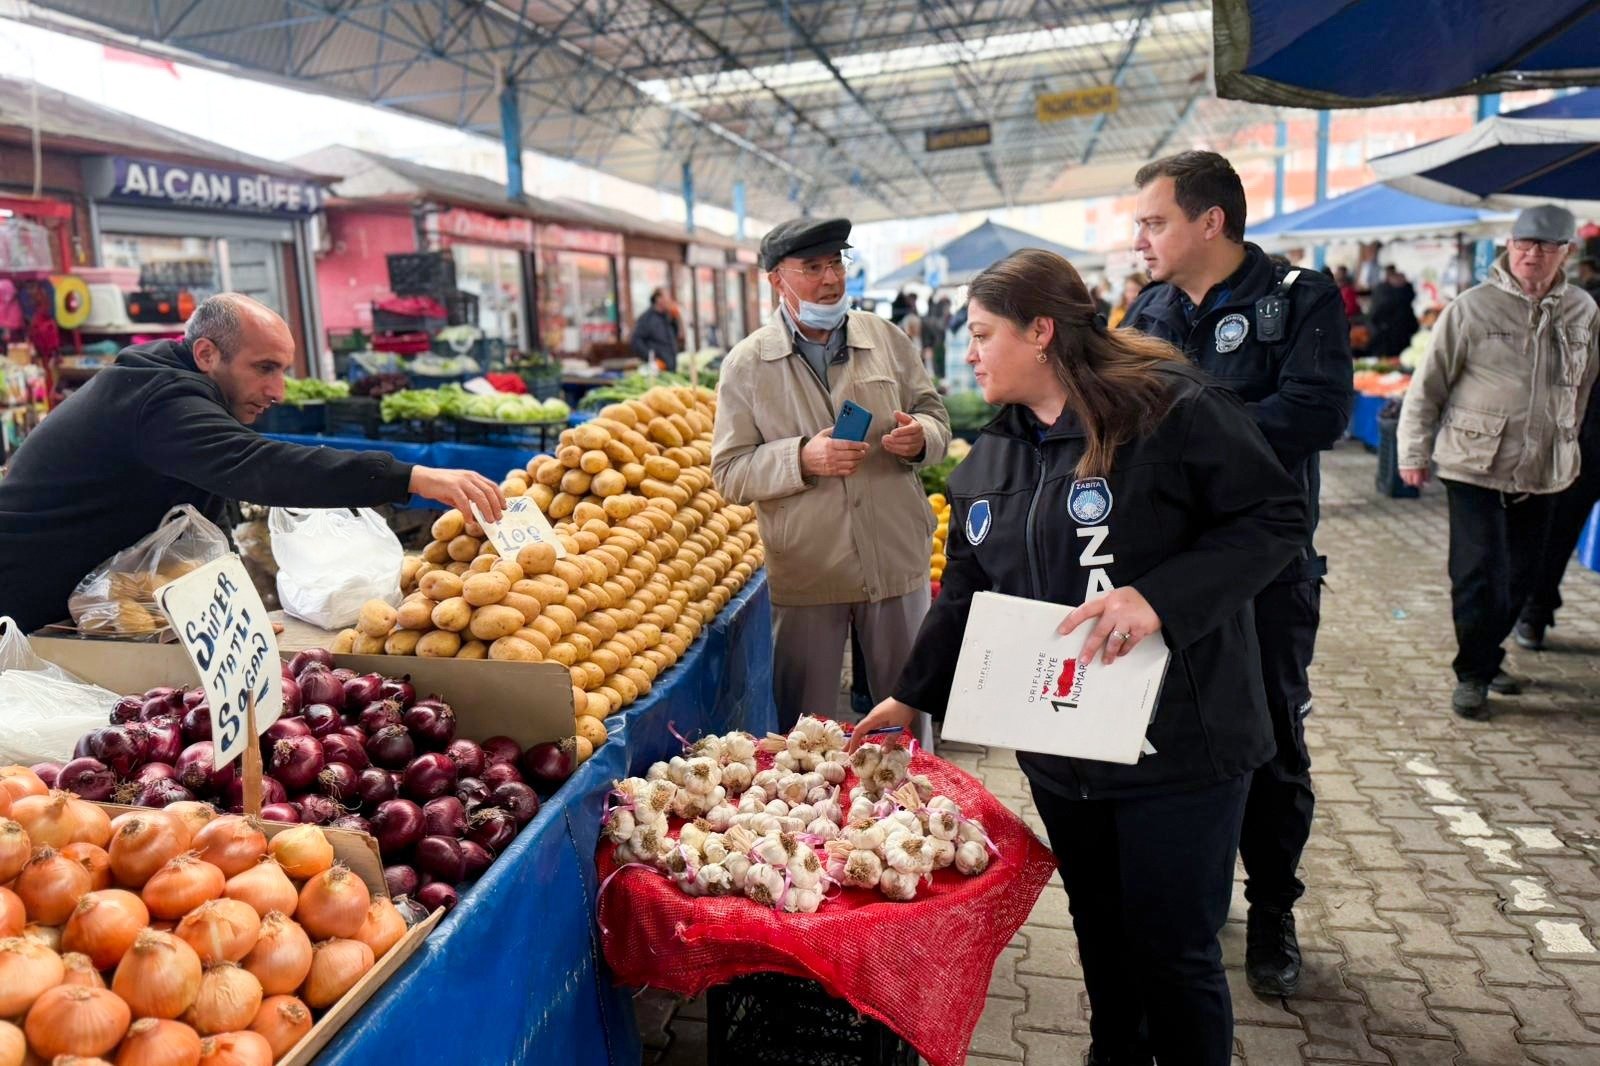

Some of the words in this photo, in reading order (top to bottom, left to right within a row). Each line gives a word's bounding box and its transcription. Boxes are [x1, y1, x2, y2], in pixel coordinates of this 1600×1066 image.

[122, 163, 232, 204] ALCAN
[238, 173, 299, 211] BÜFE
[1076, 481, 1101, 490] ZABITA
[186, 571, 238, 671] SÜPER
[213, 608, 252, 698] TATLI
[977, 649, 991, 690] ORIFLAME
[1028, 652, 1046, 703] ORIFLAME
[1051, 700, 1078, 712] 1
